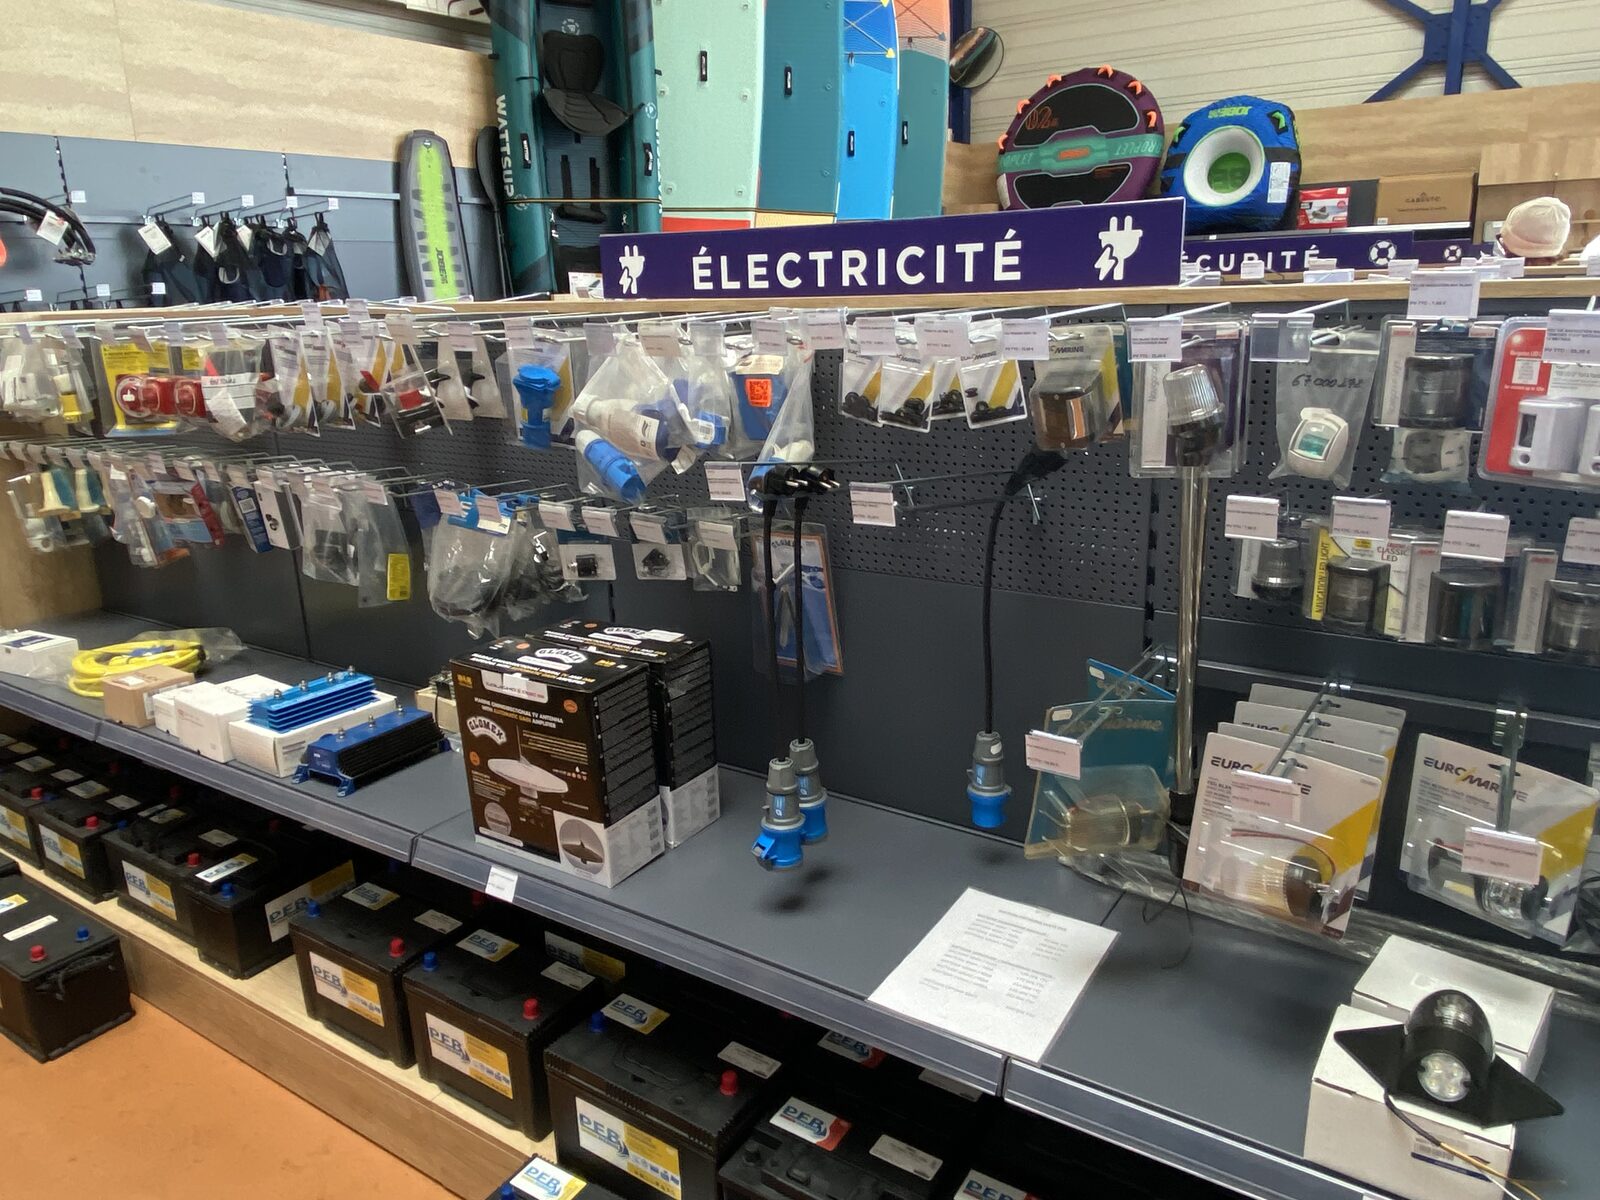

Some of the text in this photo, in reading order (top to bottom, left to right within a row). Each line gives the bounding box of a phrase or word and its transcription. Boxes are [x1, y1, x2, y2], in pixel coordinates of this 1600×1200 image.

[496, 95, 515, 198] WATTSUP
[692, 229, 1022, 291] ÉLECTRICITÉ
[469, 718, 503, 740] GLOMEX
